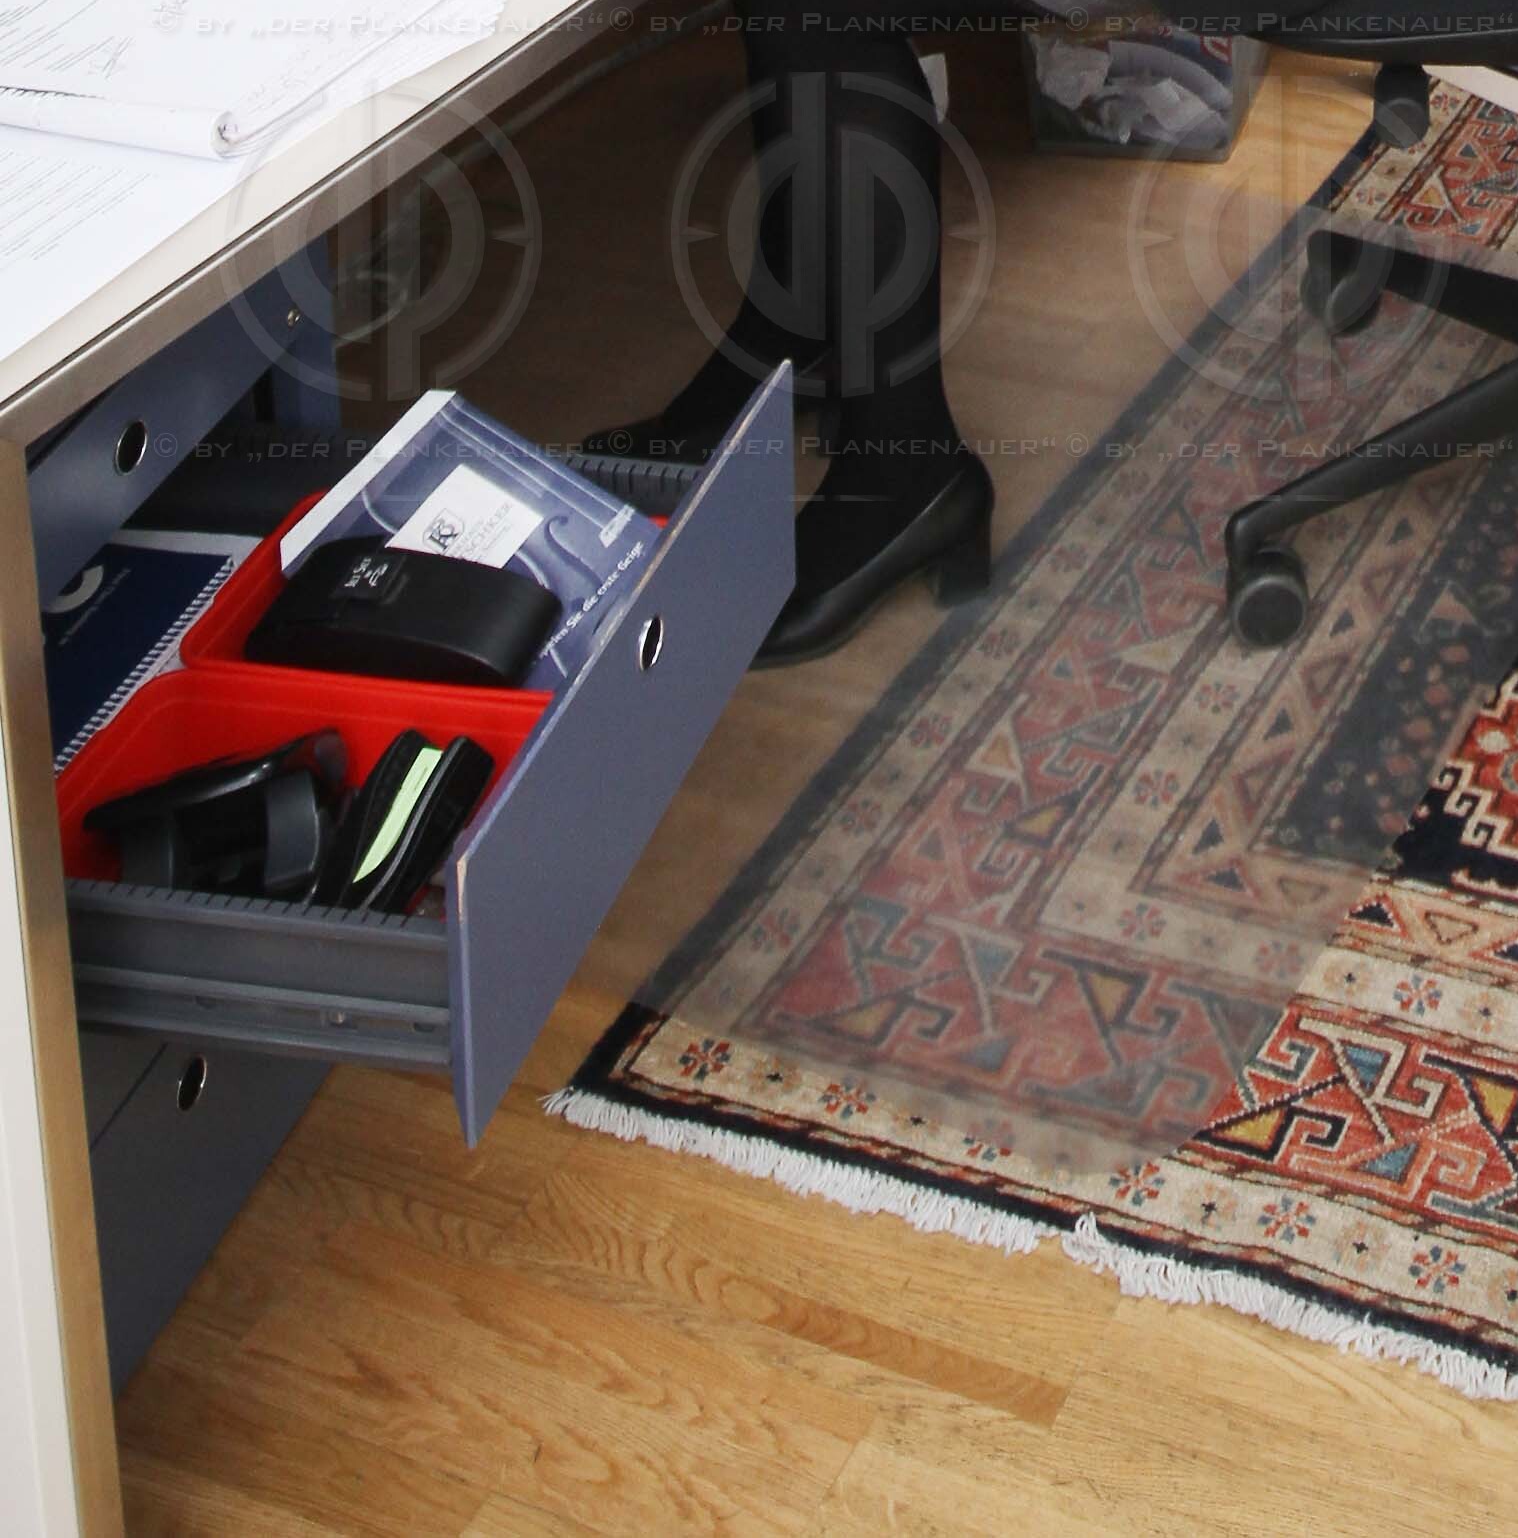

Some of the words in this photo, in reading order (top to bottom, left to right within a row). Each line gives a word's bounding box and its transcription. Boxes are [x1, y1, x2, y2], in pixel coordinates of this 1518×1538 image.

[566, 609, 585, 630] Sie
[582, 594, 600, 613] die
[597, 572, 621, 597] erste
[616, 540, 646, 572] Geige
